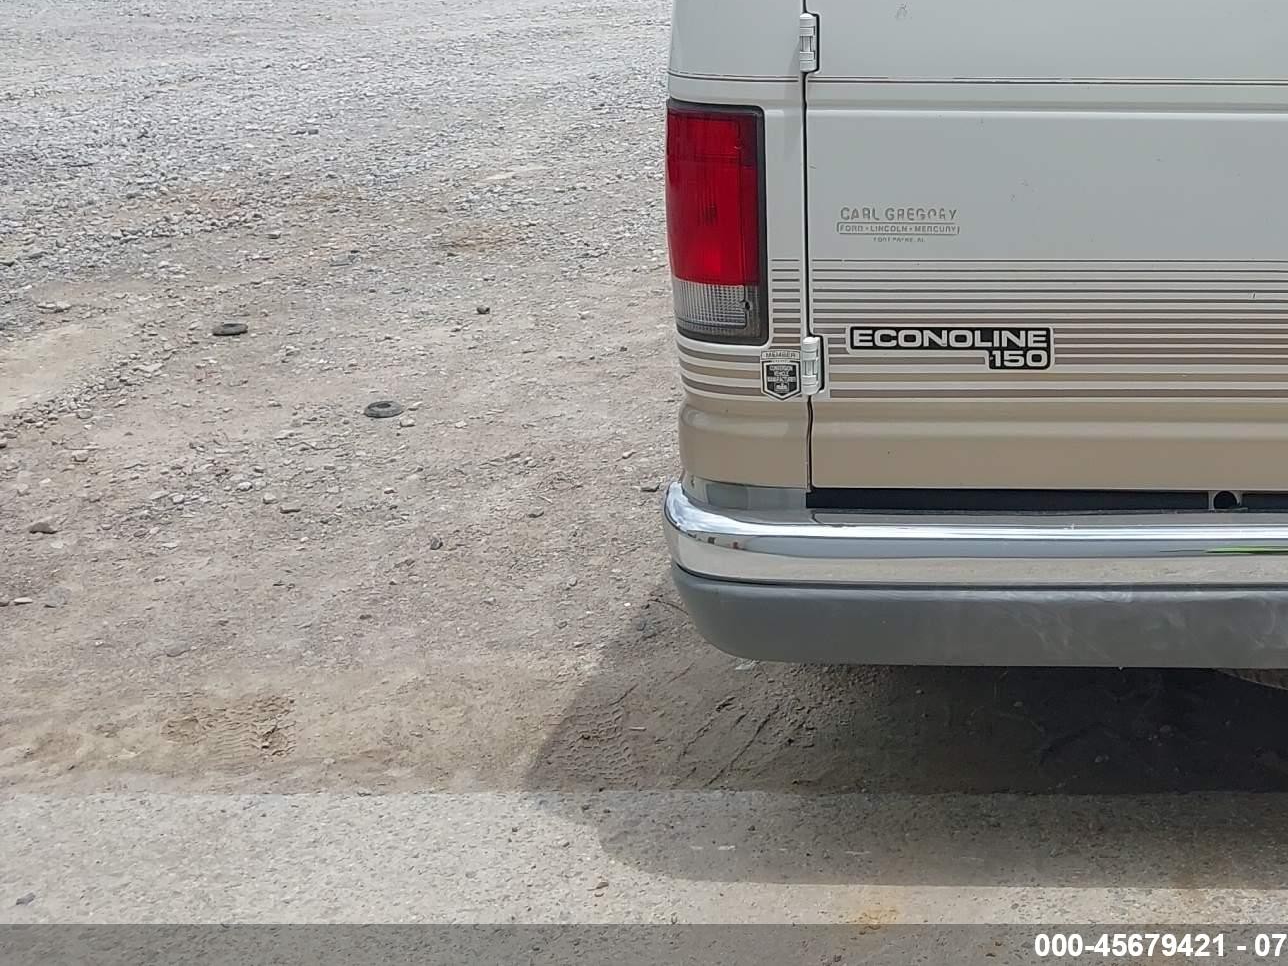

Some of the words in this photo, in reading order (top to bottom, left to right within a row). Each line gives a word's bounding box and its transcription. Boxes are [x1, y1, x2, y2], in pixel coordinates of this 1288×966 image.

[840, 206, 880, 221] CARL
[884, 207, 957, 221] GREGORY
[840, 224, 864, 233] FORD
[870, 224, 908, 233] LINCOLN
[914, 224, 957, 233] MERCURY
[853, 328, 1048, 348] ECONOLINE
[990, 349, 1048, 367] 150
